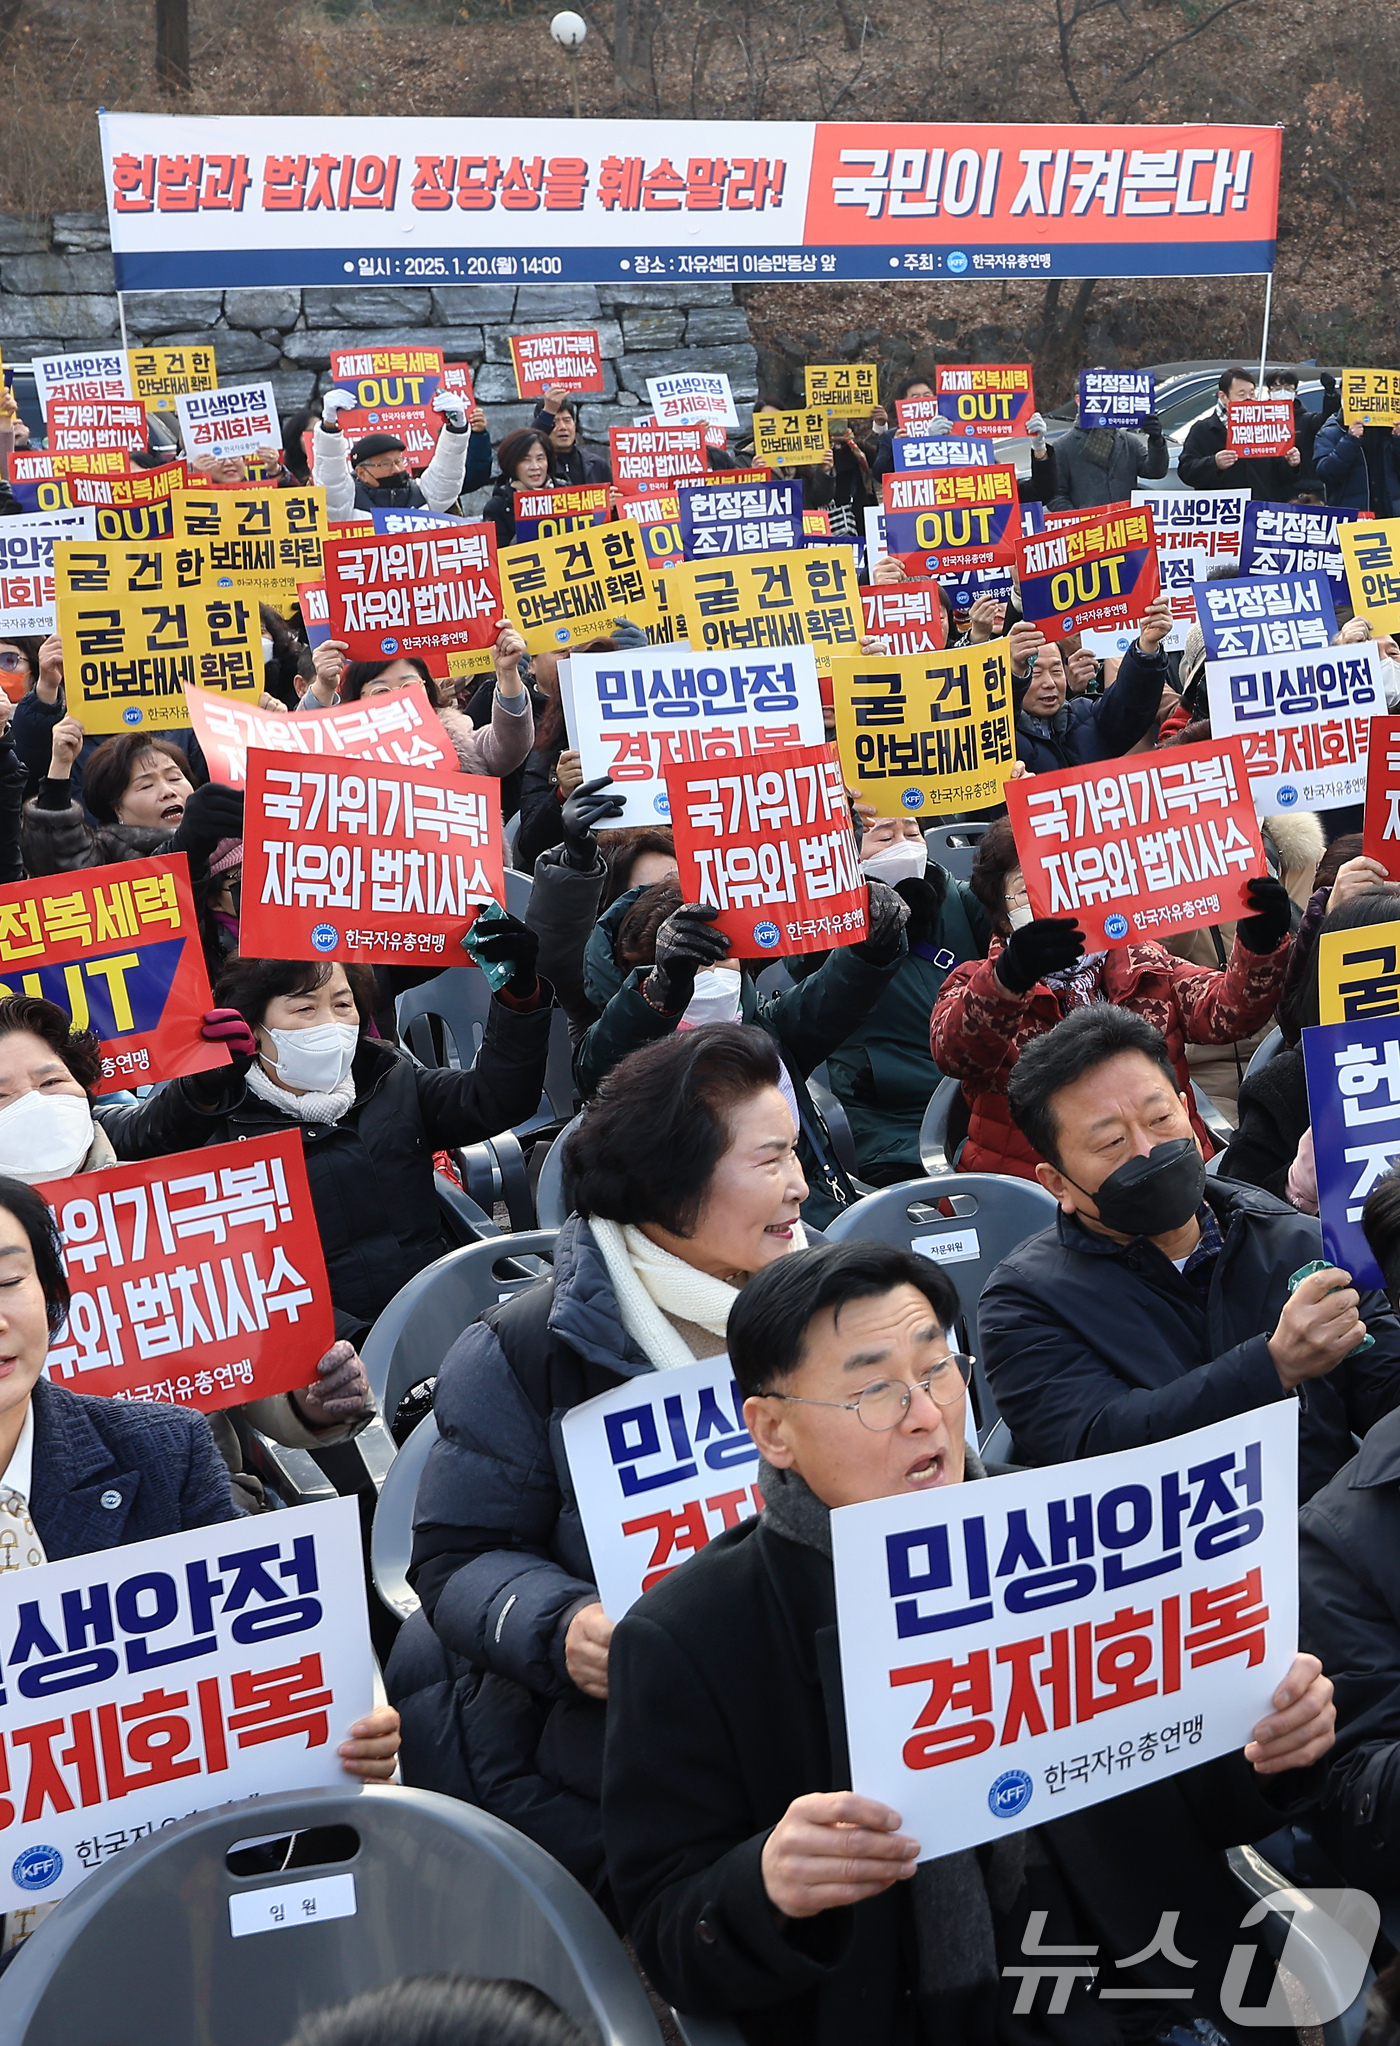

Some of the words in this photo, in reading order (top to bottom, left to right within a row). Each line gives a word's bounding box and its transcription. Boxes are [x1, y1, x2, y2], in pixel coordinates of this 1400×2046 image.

[112, 152, 251, 212] 헌법과
[262, 152, 402, 212] 법치의
[410, 155, 589, 212] 정당성을
[594, 155, 787, 212] 훼손말라!
[831, 148, 1001, 220] 국민이
[1010, 149, 1253, 218] 지켜본다!
[520, 256, 563, 275] 14:00
[677, 255, 739, 273] 자유센터
[742, 254, 817, 273] 이승만동상
[820, 254, 838, 272] 앞
[972, 253, 1051, 269] 한국자유총연맹
[518, 336, 595, 359] 국가위기극복!
[42, 356, 122, 382] 민생안정
[336, 352, 441, 378] 체제전복세력
[521, 358, 555, 382] 자유와
[555, 356, 598, 377] 법치사수
[45, 380, 125, 401] 경제회복
[138, 376, 190, 397] 안보태세
[357, 376, 425, 408] OUT
[655, 378, 724, 398] 민생안정
[941, 370, 1029, 391] 체제전복세력
[1085, 373, 1150, 395] 헌정질서
[185, 389, 268, 420] 민생안정
[660, 396, 728, 417] 경제회복
[812, 389, 852, 406] 안보태세
[853, 389, 873, 405] 확립
[957, 393, 1014, 421] OUT
[1083, 395, 1151, 416] 조기회복
[1348, 396, 1389, 413] 안보태세
[54, 405, 142, 427] 국가위기극복!
[382, 410, 426, 422] 한국자유총연맹
[1229, 404, 1290, 424] 국가위기극복!
[55, 429, 95, 450] 자유와
[189, 414, 271, 445] 경제회복
[616, 431, 701, 454] 국가위기극복!
[760, 436, 803, 455] 안보태세
[803, 434, 825, 452] 확립
[1230, 425, 1255, 445] 자유와
[1254, 424, 1292, 444] 법치사수
[617, 456, 654, 479] 자유와
[655, 454, 704, 478] 법치사수
[902, 442, 989, 467] 헌정질서
[519, 489, 607, 518] 체제전복세력
[689, 487, 794, 523] 헌정질서
[890, 472, 1013, 509] 체제전복세력
[97, 501, 169, 541] OUT
[1144, 497, 1241, 526] 민생안정
[692, 520, 795, 555] 조기회복
[915, 507, 995, 550] OUT
[209, 539, 276, 570] 보태세
[279, 537, 323, 569] 확립
[337, 534, 490, 586] 국가위기극복!
[941, 552, 994, 568] 한국자유총연맹
[1023, 515, 1149, 575] 체제전복세력
[1248, 546, 1345, 582] 조기회복
[1050, 555, 1126, 612] OUT
[341, 587, 411, 633] 자유와
[411, 578, 497, 626] 법치사수
[517, 580, 608, 630] 안보태세
[605, 569, 647, 606] 확립
[1074, 602, 1129, 626] 한국자유총연맹
[1204, 579, 1322, 622] 헌정질서
[0, 616, 54, 630] 국자유총연맹
[702, 612, 806, 651] 안보태세
[805, 606, 857, 646] 확립
[1213, 617, 1329, 659] 조기회복
[401, 631, 470, 651] 한국자유총연맹
[80, 655, 197, 701] 안보태세
[199, 651, 256, 692] 확립
[595, 662, 799, 720] 민생안정
[1229, 657, 1376, 722] 민생안정
[203, 696, 425, 753] 국가위기극복!
[854, 723, 978, 780] 안보태세
[980, 714, 1013, 766] 확립
[928, 779, 998, 805] 한국자유총연맹
[1026, 754, 1241, 842] 국가위기극복!
[262, 768, 489, 847] 국가위기극복!
[260, 840, 366, 911] 자유와
[370, 845, 497, 917] 법치사수
[693, 841, 797, 911] 자유와
[1039, 840, 1140, 914] 자유와
[1136, 816, 1256, 898] 법치사수
[785, 907, 866, 942] 한국자유총연맹
[1131, 893, 1222, 931] 한국자유총연맹
[344, 927, 447, 953] 한국자유총연맹
[931, 1241, 964, 1255] 자문위원
[123, 1246, 313, 1361] 법치사수
[884, 1440, 1265, 1640] 민생안정
[0, 1534, 324, 1700] 생안정
[888, 1565, 1271, 1772] 경제회복
[1043, 1714, 1205, 1796] 한국자유총연맹
[996, 1783, 1026, 1806] KFF
[20, 1858, 54, 1879] KFF
